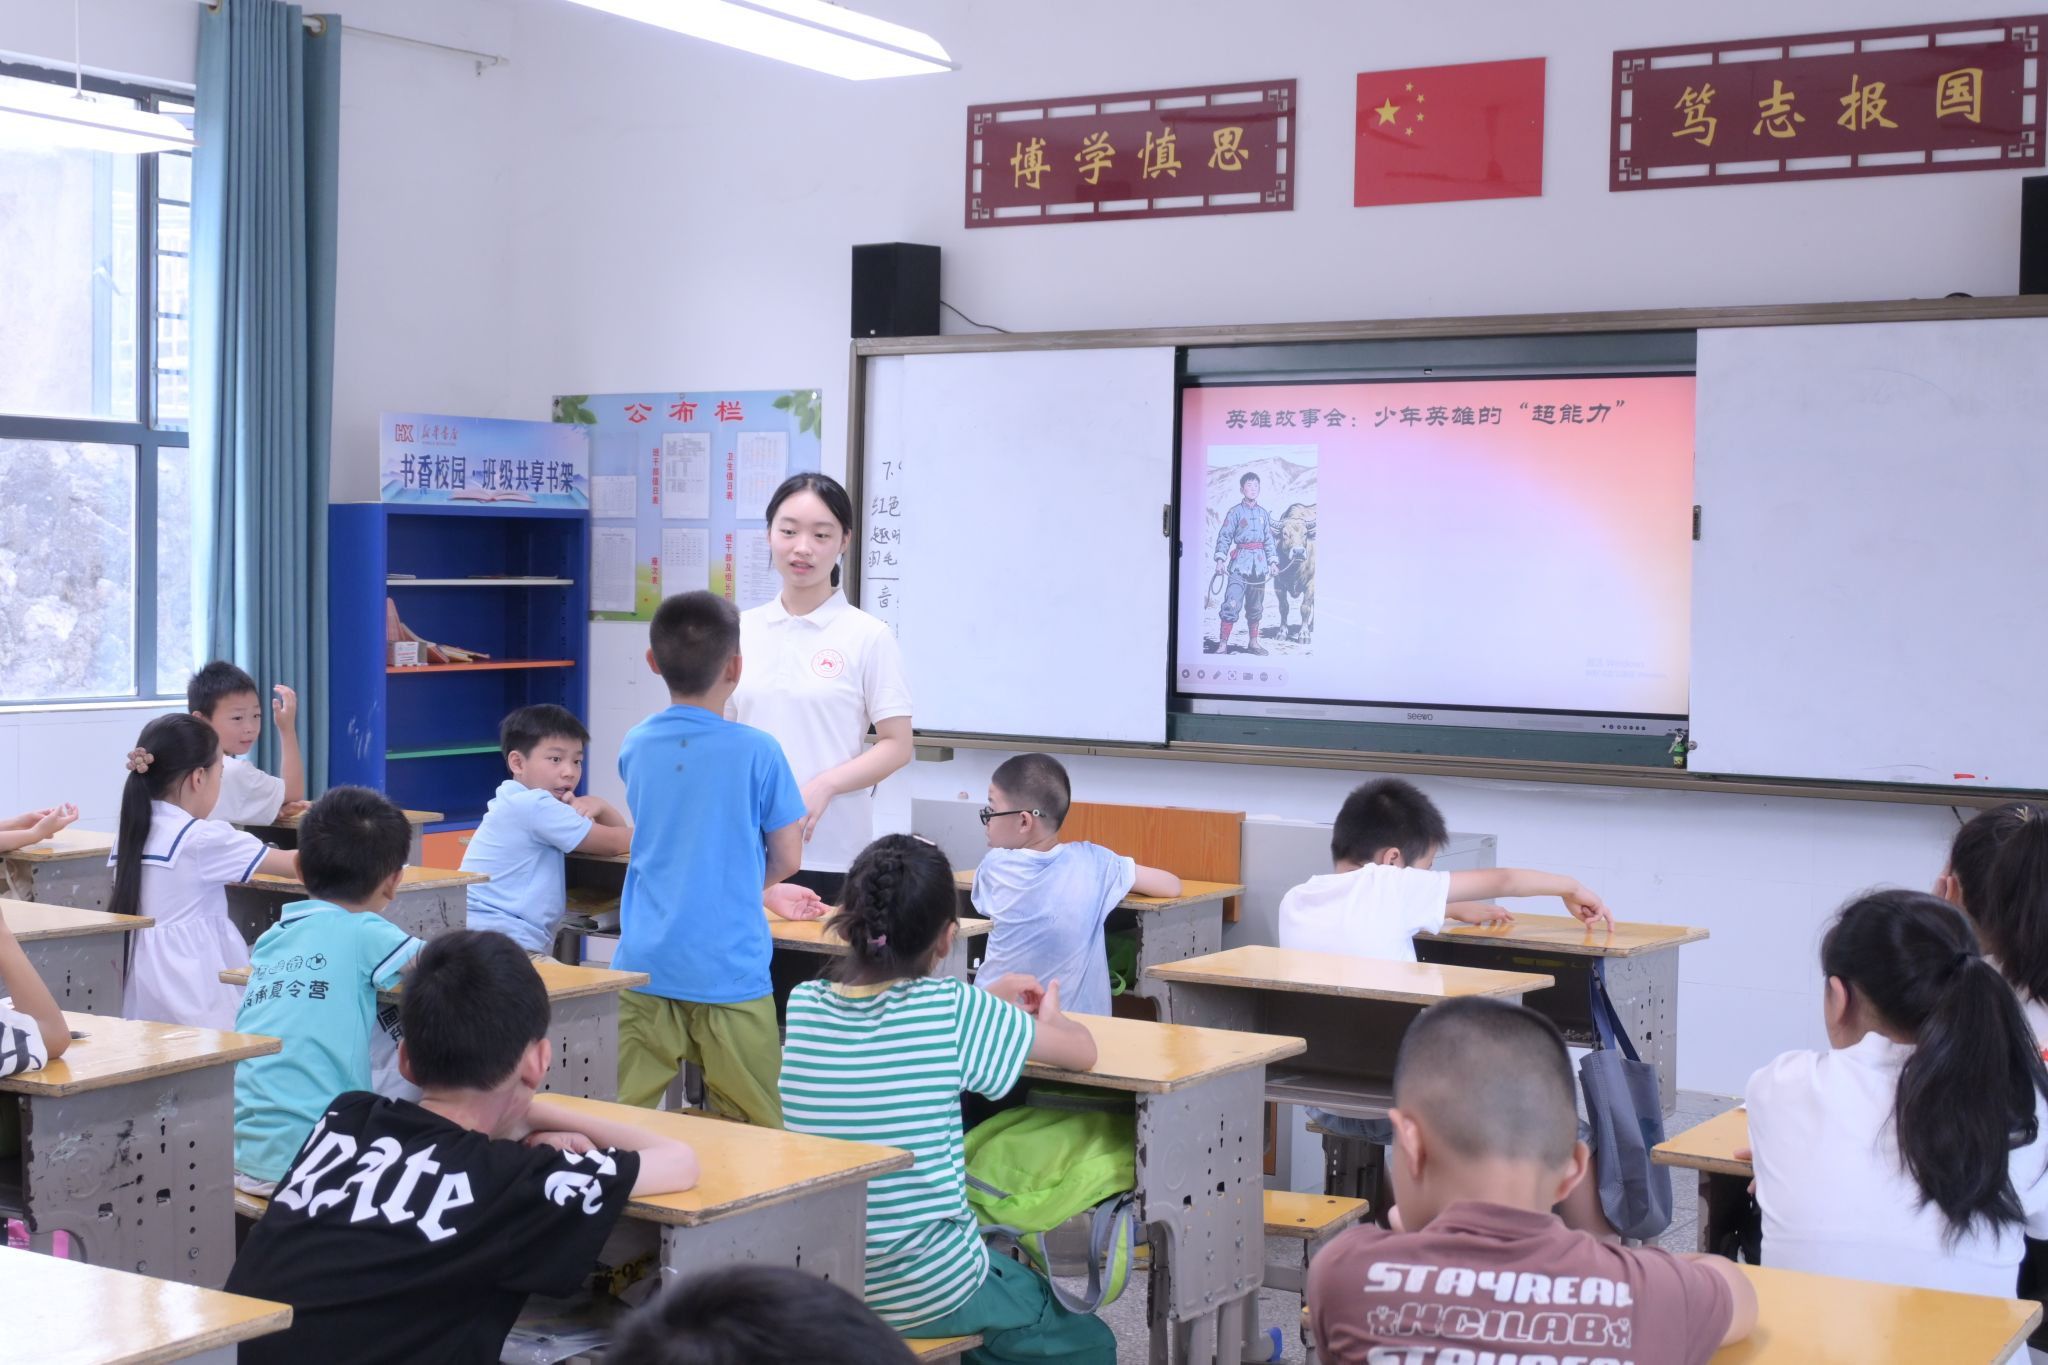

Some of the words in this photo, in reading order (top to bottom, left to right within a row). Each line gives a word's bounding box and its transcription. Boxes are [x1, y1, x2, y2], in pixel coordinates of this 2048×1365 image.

[1672, 67, 1983, 147] 笃志报国
[1010, 126, 1249, 190] 博学慎思
[624, 400, 744, 424] 公布栏
[1363, 1261, 1634, 1308] STAYREAL
